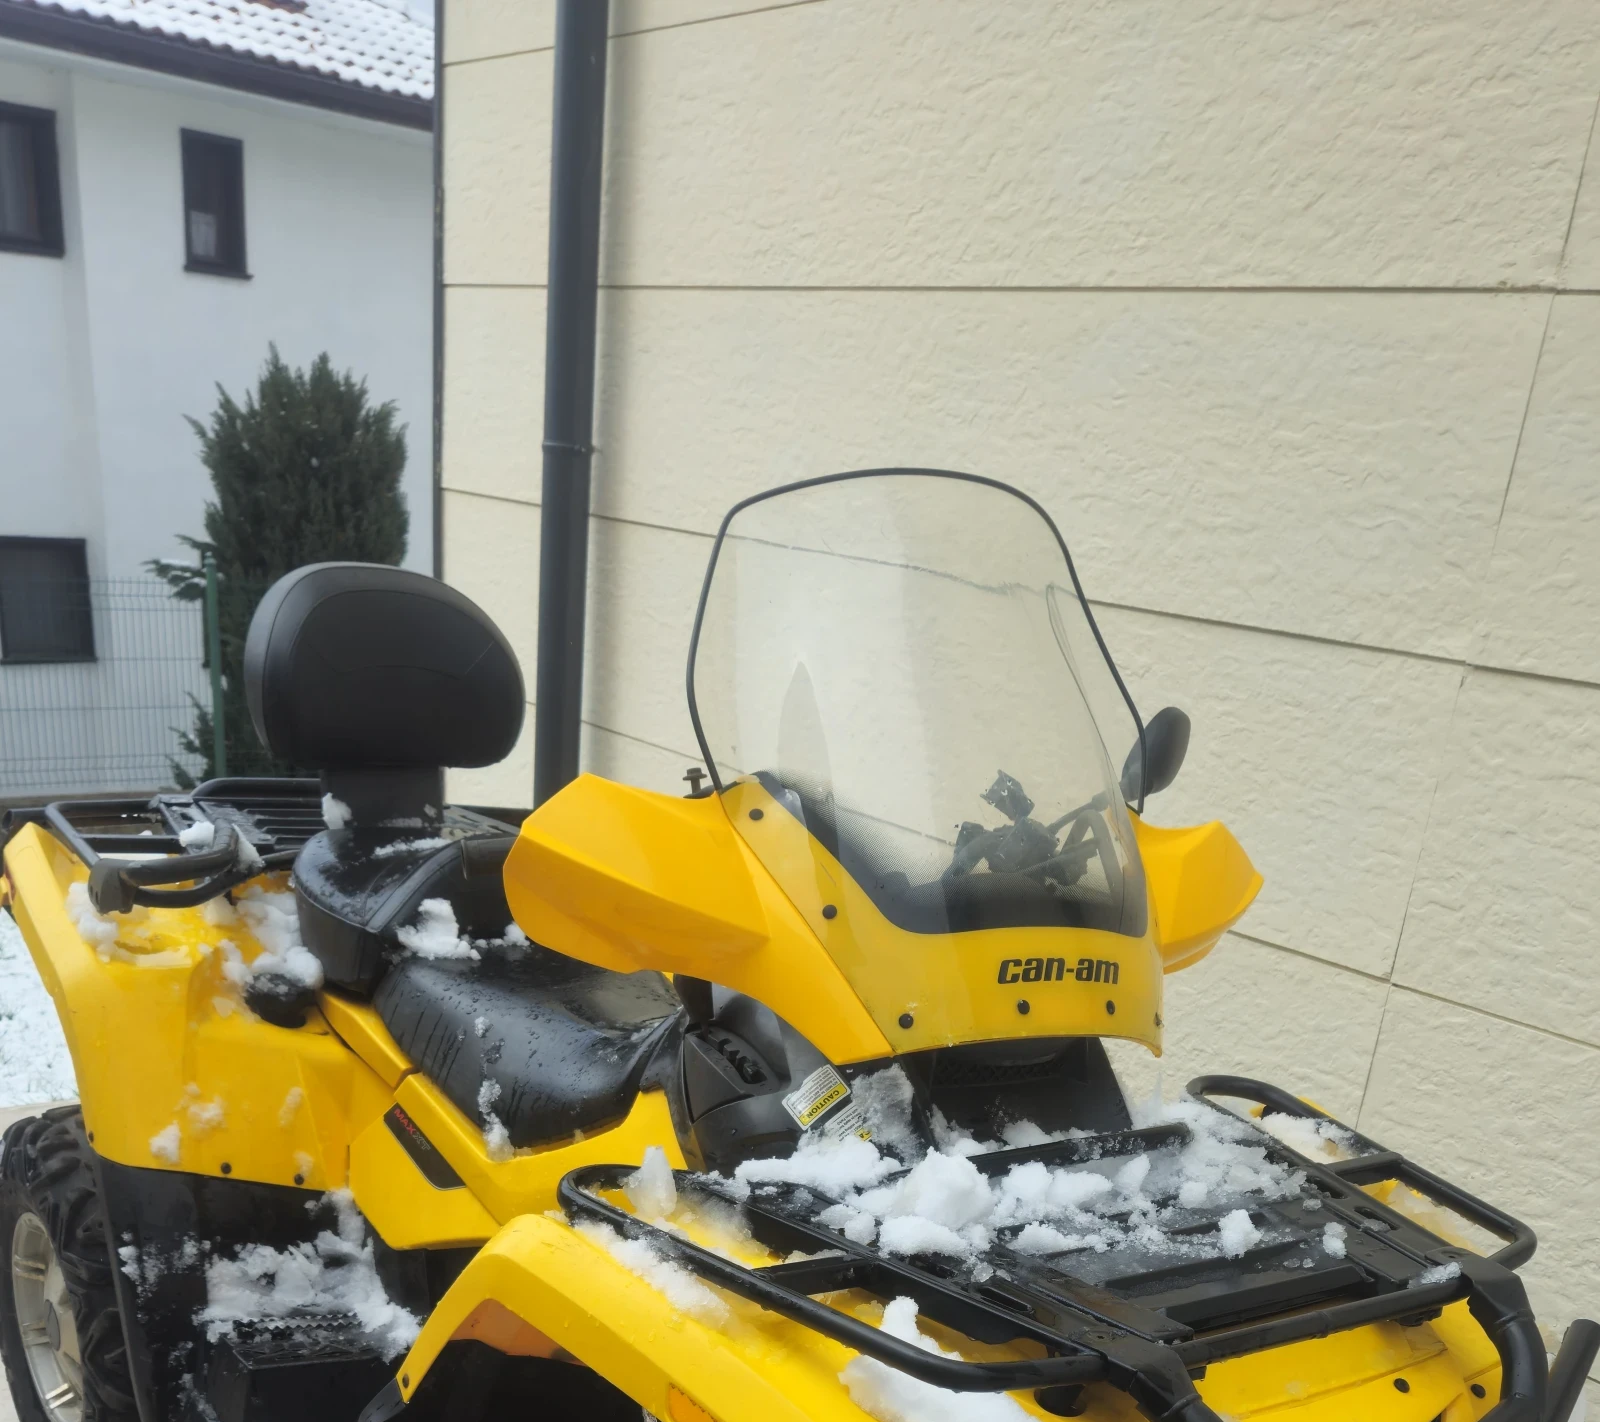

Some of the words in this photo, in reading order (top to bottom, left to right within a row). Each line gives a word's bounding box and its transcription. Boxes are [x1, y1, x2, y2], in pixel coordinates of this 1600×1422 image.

[997, 957, 1120, 985] can-am
[805, 1089, 840, 1119] CAUTION
[394, 1108, 416, 1136] MAX
[412, 1131, 431, 1151] XT
